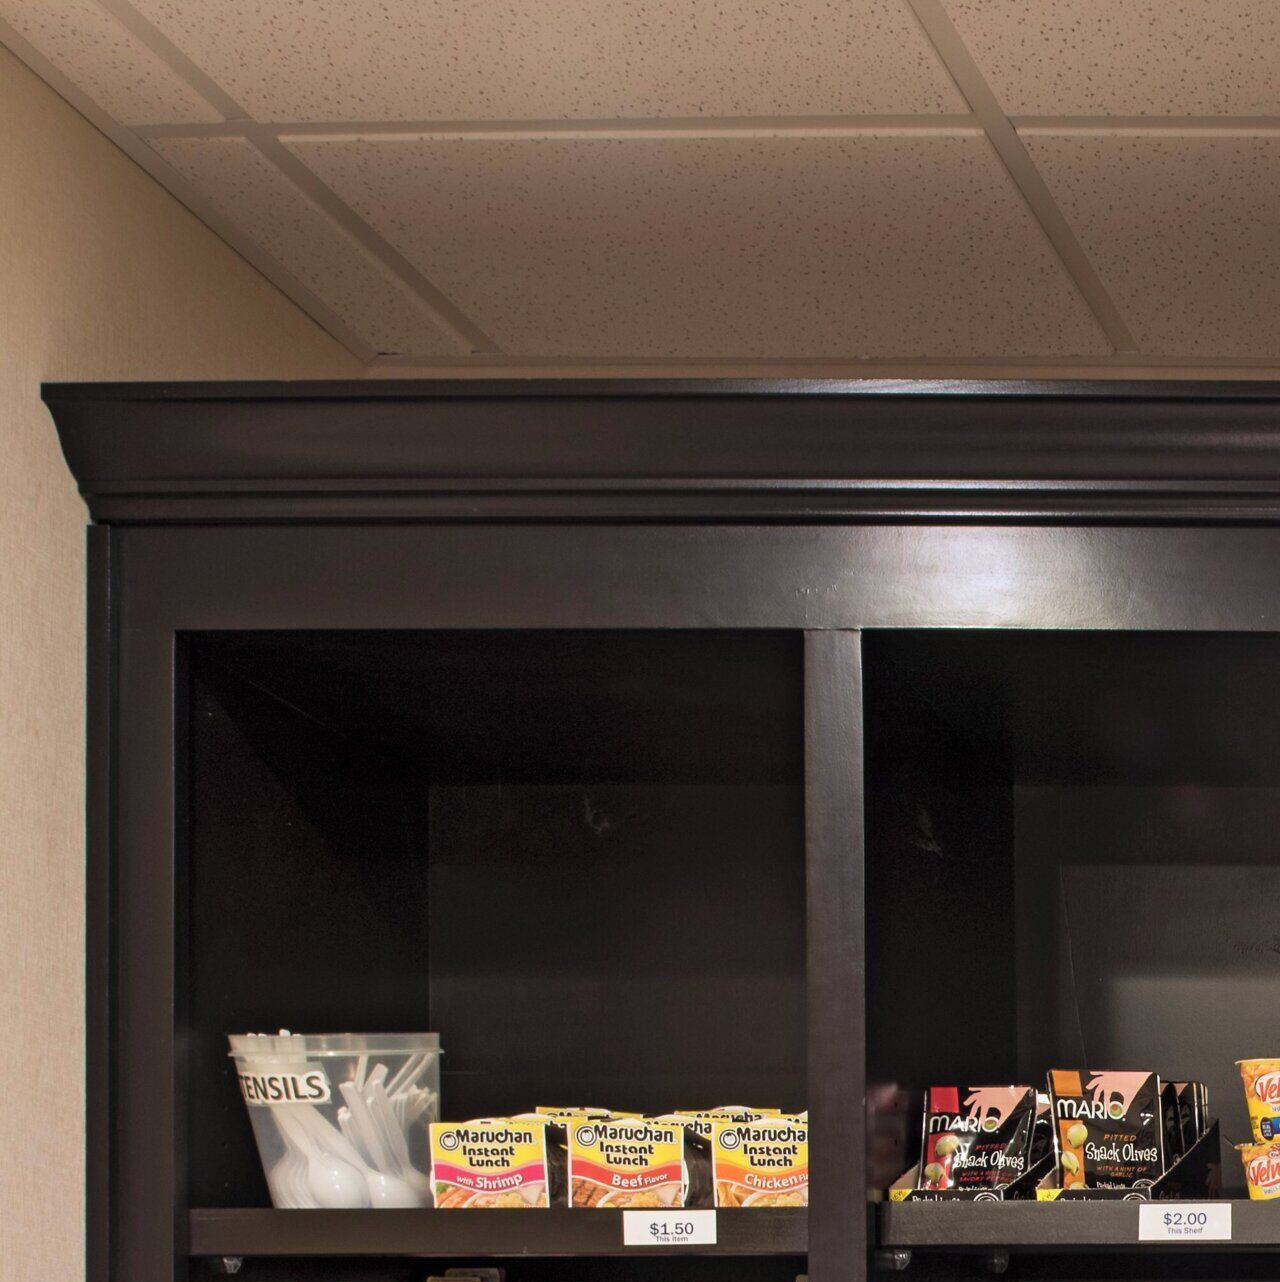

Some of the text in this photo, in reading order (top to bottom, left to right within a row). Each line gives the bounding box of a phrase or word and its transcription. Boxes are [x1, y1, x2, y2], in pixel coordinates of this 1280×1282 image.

[456, 1130, 533, 1143] Maruchan
[594, 1125, 674, 1142] Maruchan
[1104, 1134, 1136, 1142] PITTED
[462, 1146, 515, 1156] Instant
[600, 1142, 654, 1154] Instant
[743, 1144, 797, 1155] Instant
[1085, 1143, 1158, 1161] Snack Olives
[469, 1157, 510, 1167] Lunch
[606, 1155, 648, 1165] Lunch
[750, 1156, 793, 1167] Lunch
[456, 1173, 523, 1189] with Shrimp
[612, 1174, 643, 1186] Beef
[745, 1174, 798, 1188] Chicken
[1163, 1212, 1207, 1225] $2.00
[650, 1223, 694, 1236] $1.50
